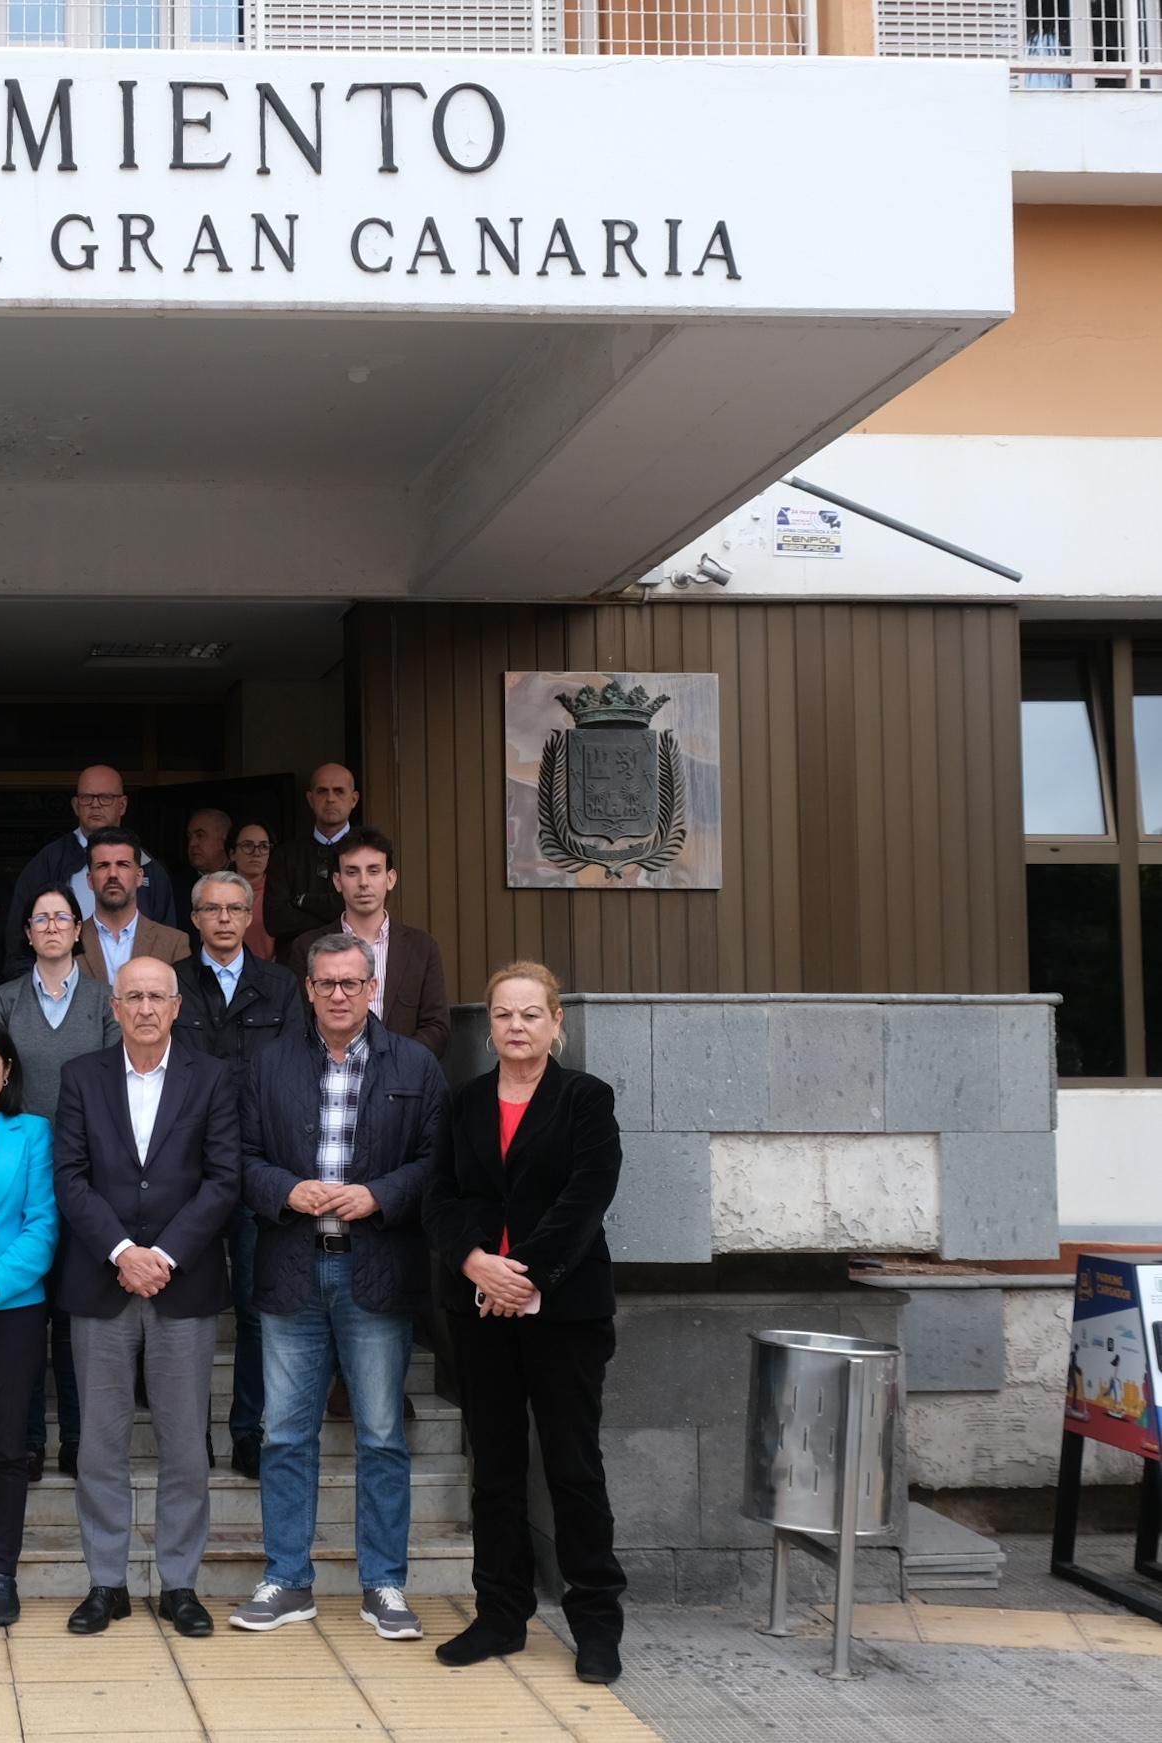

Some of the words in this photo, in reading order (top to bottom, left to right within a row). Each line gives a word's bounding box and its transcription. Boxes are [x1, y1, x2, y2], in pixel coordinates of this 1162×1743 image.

[50, 213, 299, 273] GRAN
[350, 216, 742, 281] CANARIA
[782, 535, 835, 544] CENPOL
[781, 544, 836, 553] SEGURIDAD
[1096, 1272, 1123, 1286] PARKING
[1096, 1284, 1132, 1301] CARGADOR
